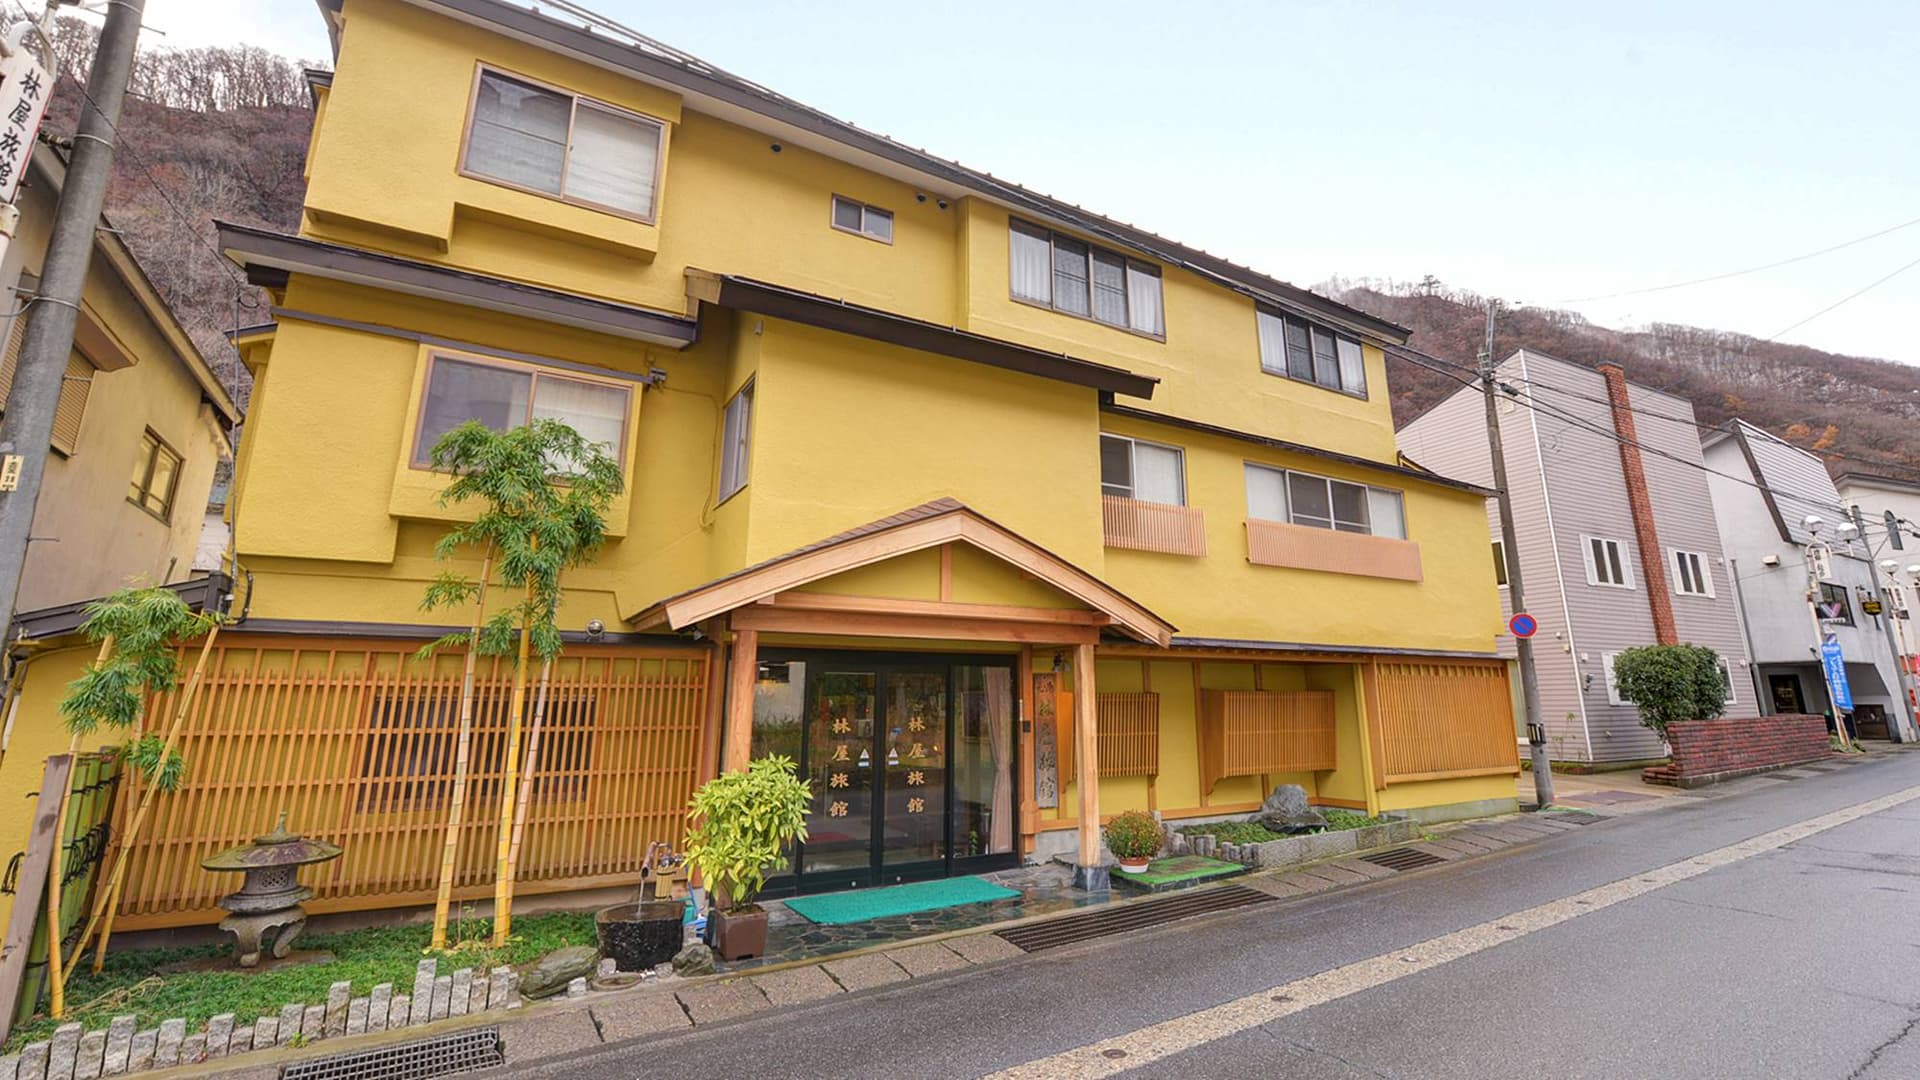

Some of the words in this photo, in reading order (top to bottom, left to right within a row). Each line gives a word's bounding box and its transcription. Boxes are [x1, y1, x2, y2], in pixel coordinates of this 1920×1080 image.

[829, 717, 851, 817] 林屋旅館
[907, 716, 926, 814] 林屋旅館
